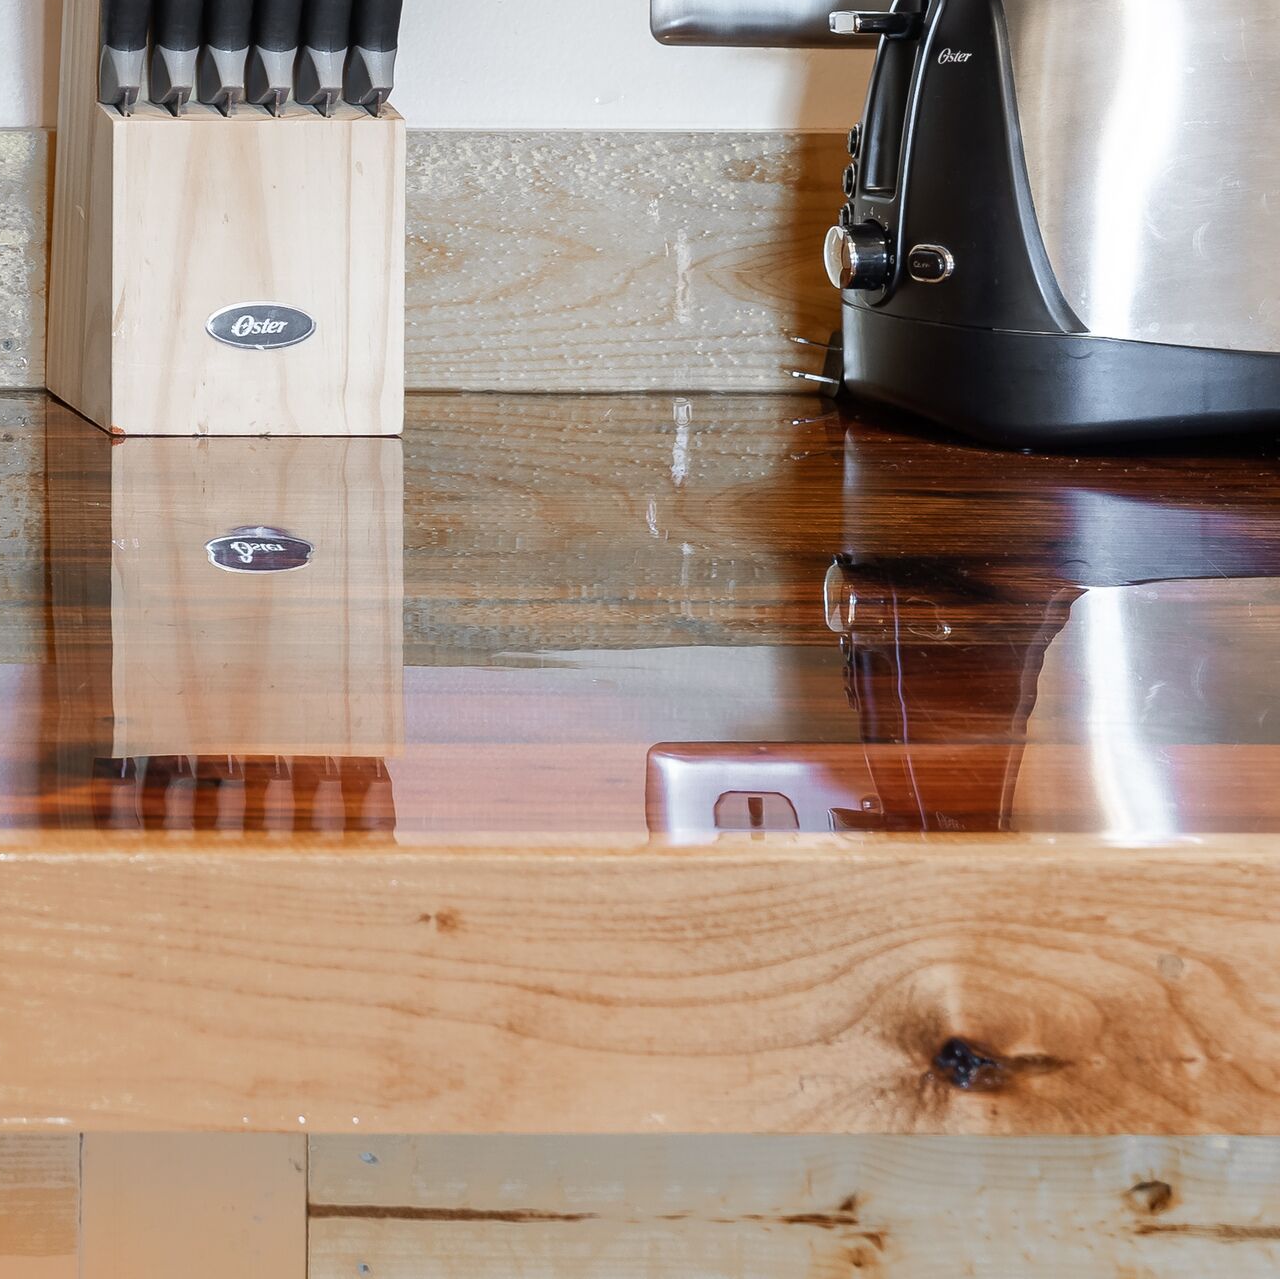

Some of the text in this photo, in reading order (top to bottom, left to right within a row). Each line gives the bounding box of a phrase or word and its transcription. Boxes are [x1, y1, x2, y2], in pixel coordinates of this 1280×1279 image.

[937, 47, 972, 64] Oster
[884, 222, 889, 231] 5
[890, 255, 895, 264] 6
[231, 315, 288, 336] Oster
